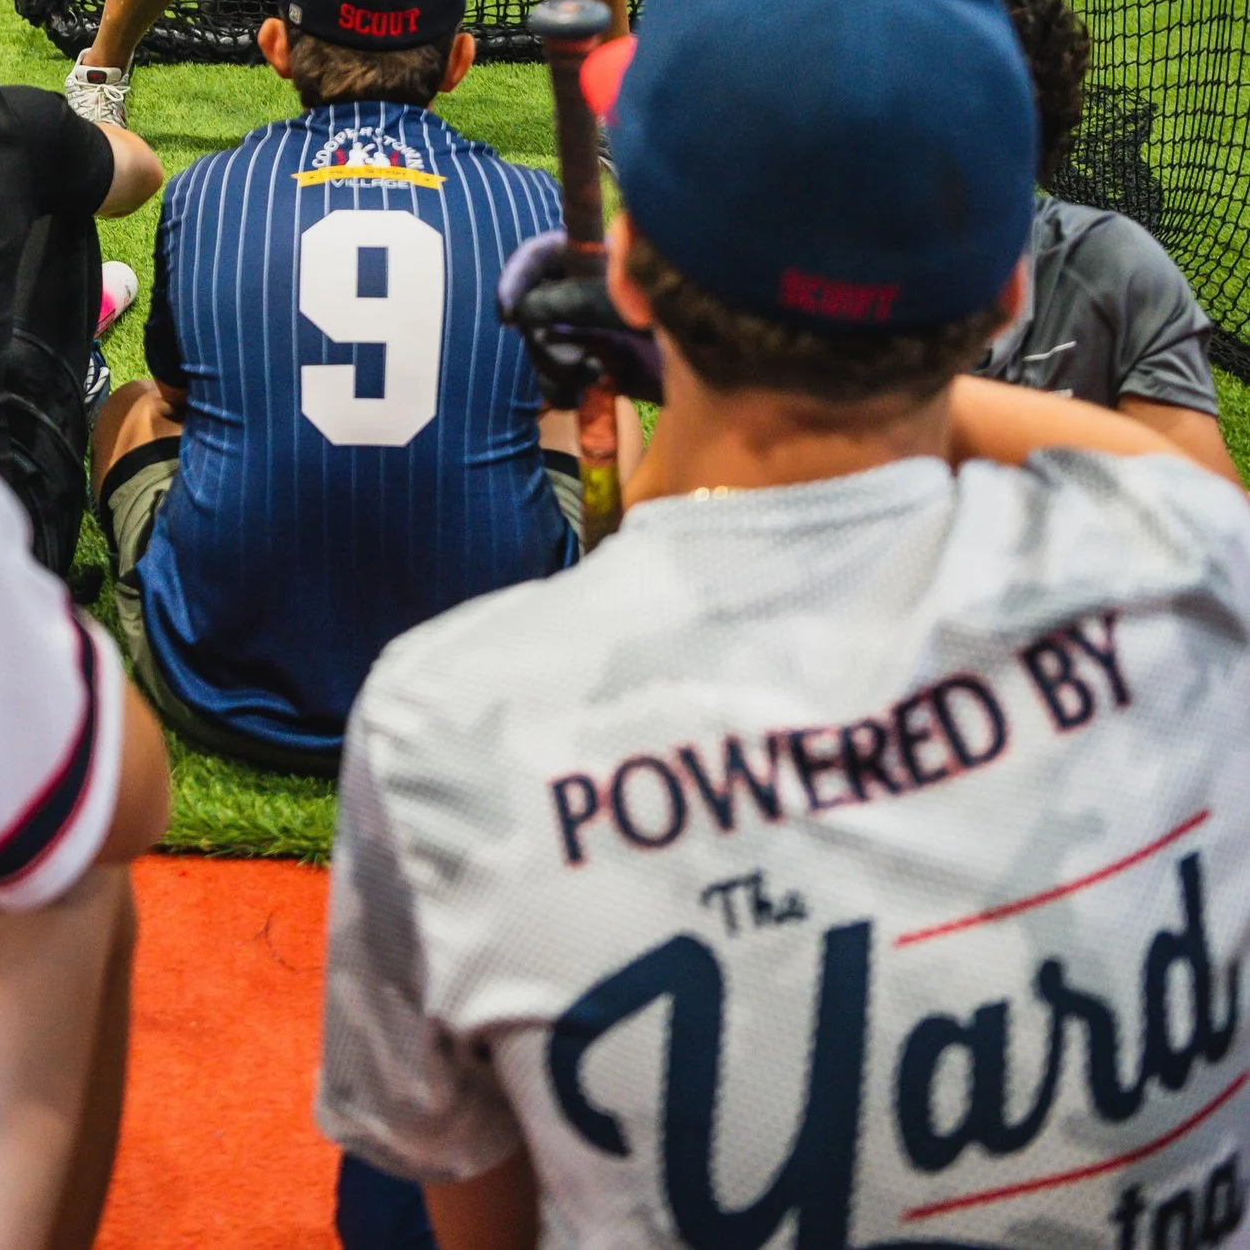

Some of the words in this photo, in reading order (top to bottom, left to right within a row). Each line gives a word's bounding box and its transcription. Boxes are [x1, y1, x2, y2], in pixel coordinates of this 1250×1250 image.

[338, 3, 421, 37] SCOUT
[330, 178, 410, 190] VILLAGE
[299, 209, 445, 447] 9
[549, 675, 1009, 865] POWERED
[1017, 610, 1133, 733] BY
[702, 867, 808, 938] The
[546, 852, 1247, 1250] Yard
